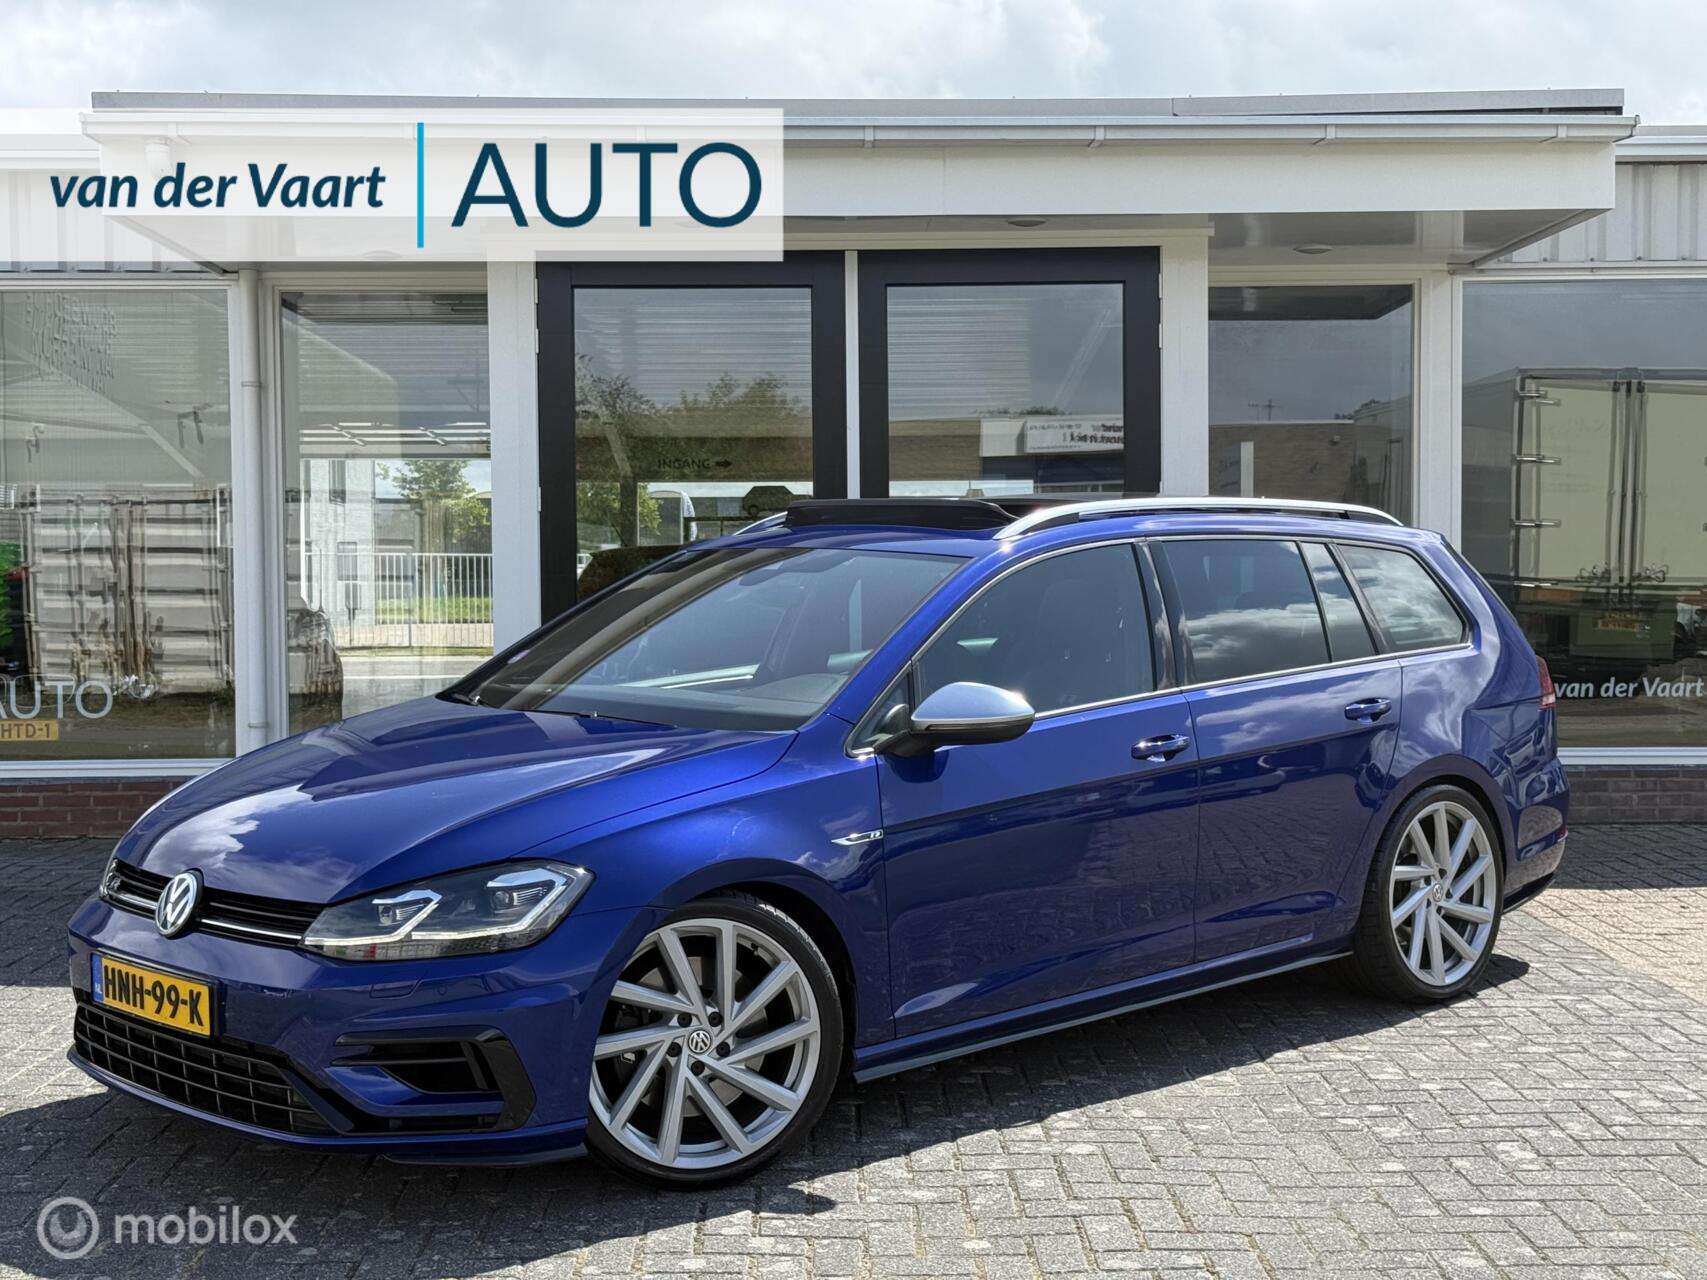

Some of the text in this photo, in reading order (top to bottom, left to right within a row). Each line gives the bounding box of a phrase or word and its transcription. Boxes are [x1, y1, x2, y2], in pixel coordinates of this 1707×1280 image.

[0, 680, 113, 719] UTO
[1553, 677, 1705, 698] van der Vaart
[104, 964, 204, 1027] HNH-99-K
